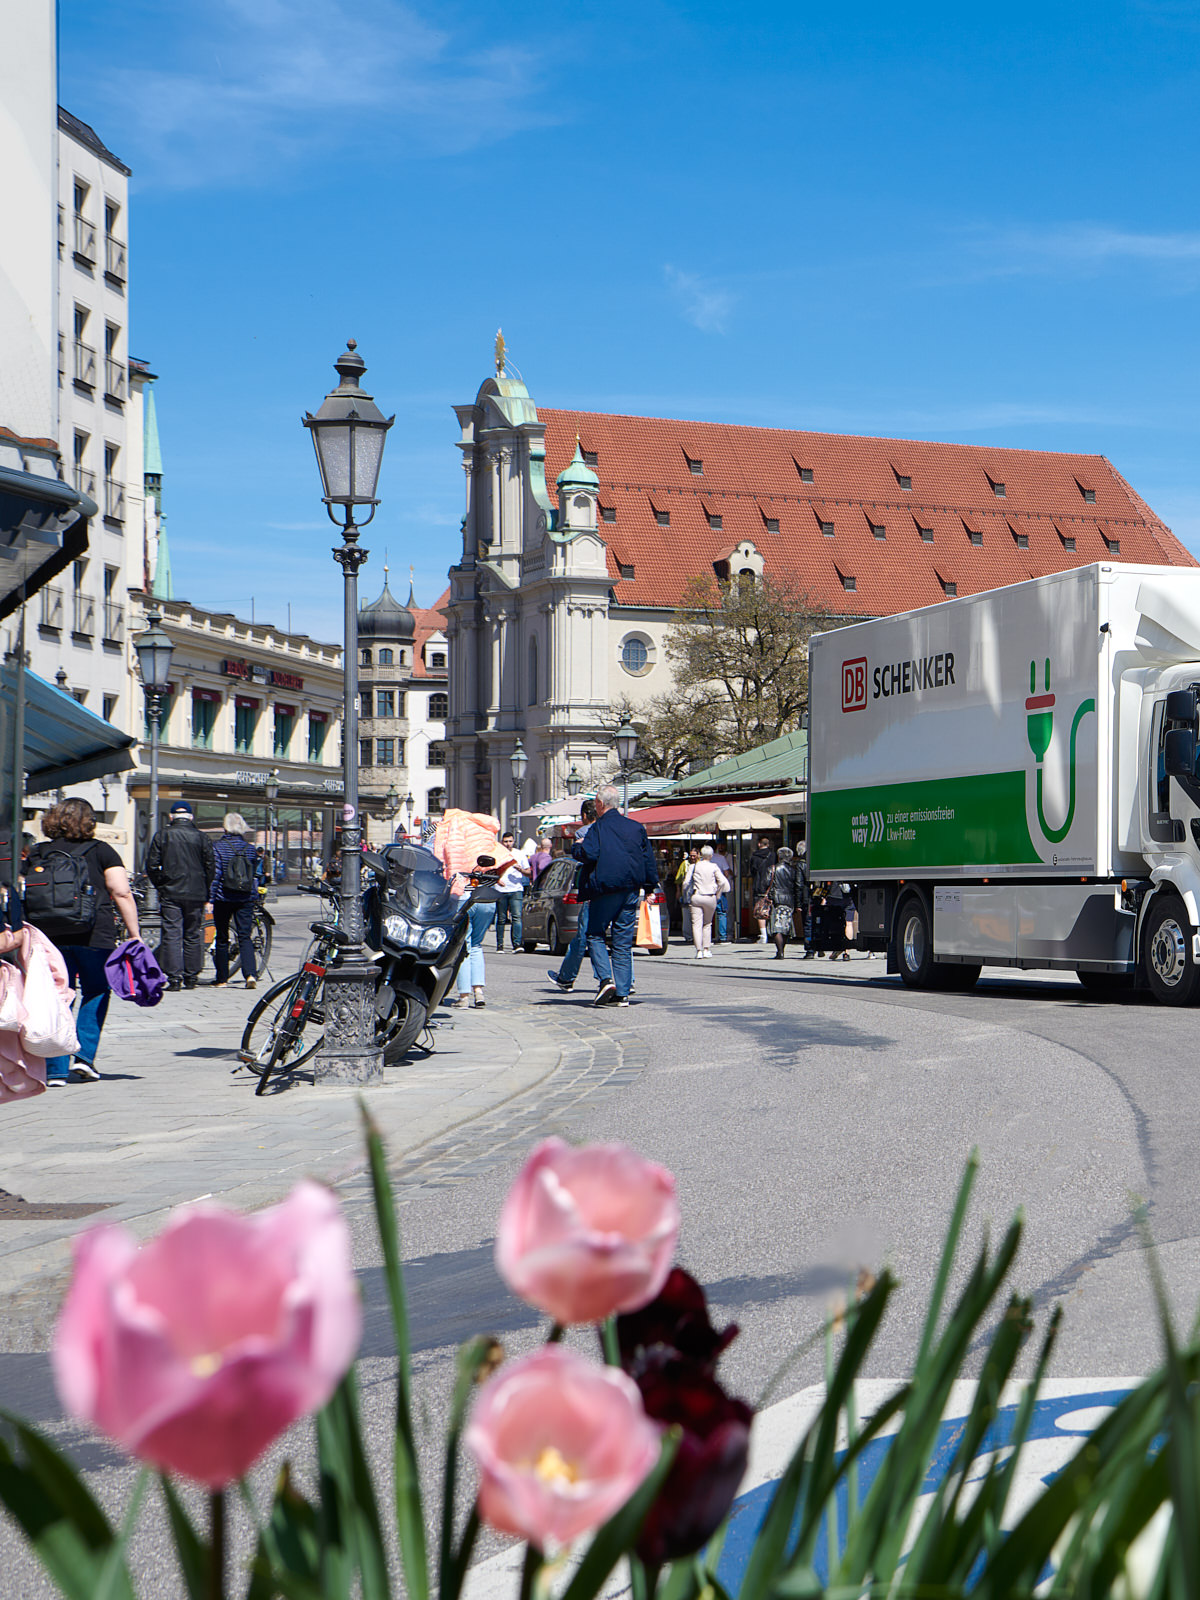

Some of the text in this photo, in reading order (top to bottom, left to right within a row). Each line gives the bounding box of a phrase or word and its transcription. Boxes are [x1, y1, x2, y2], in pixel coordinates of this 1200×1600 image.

[844, 652, 956, 705] DB SCHENKER
[851, 812, 868, 826] on the
[886, 806, 955, 824] zu einer emissionsfreien
[852, 828, 868, 847] way
[886, 827, 916, 841] Lkw-Flotte
